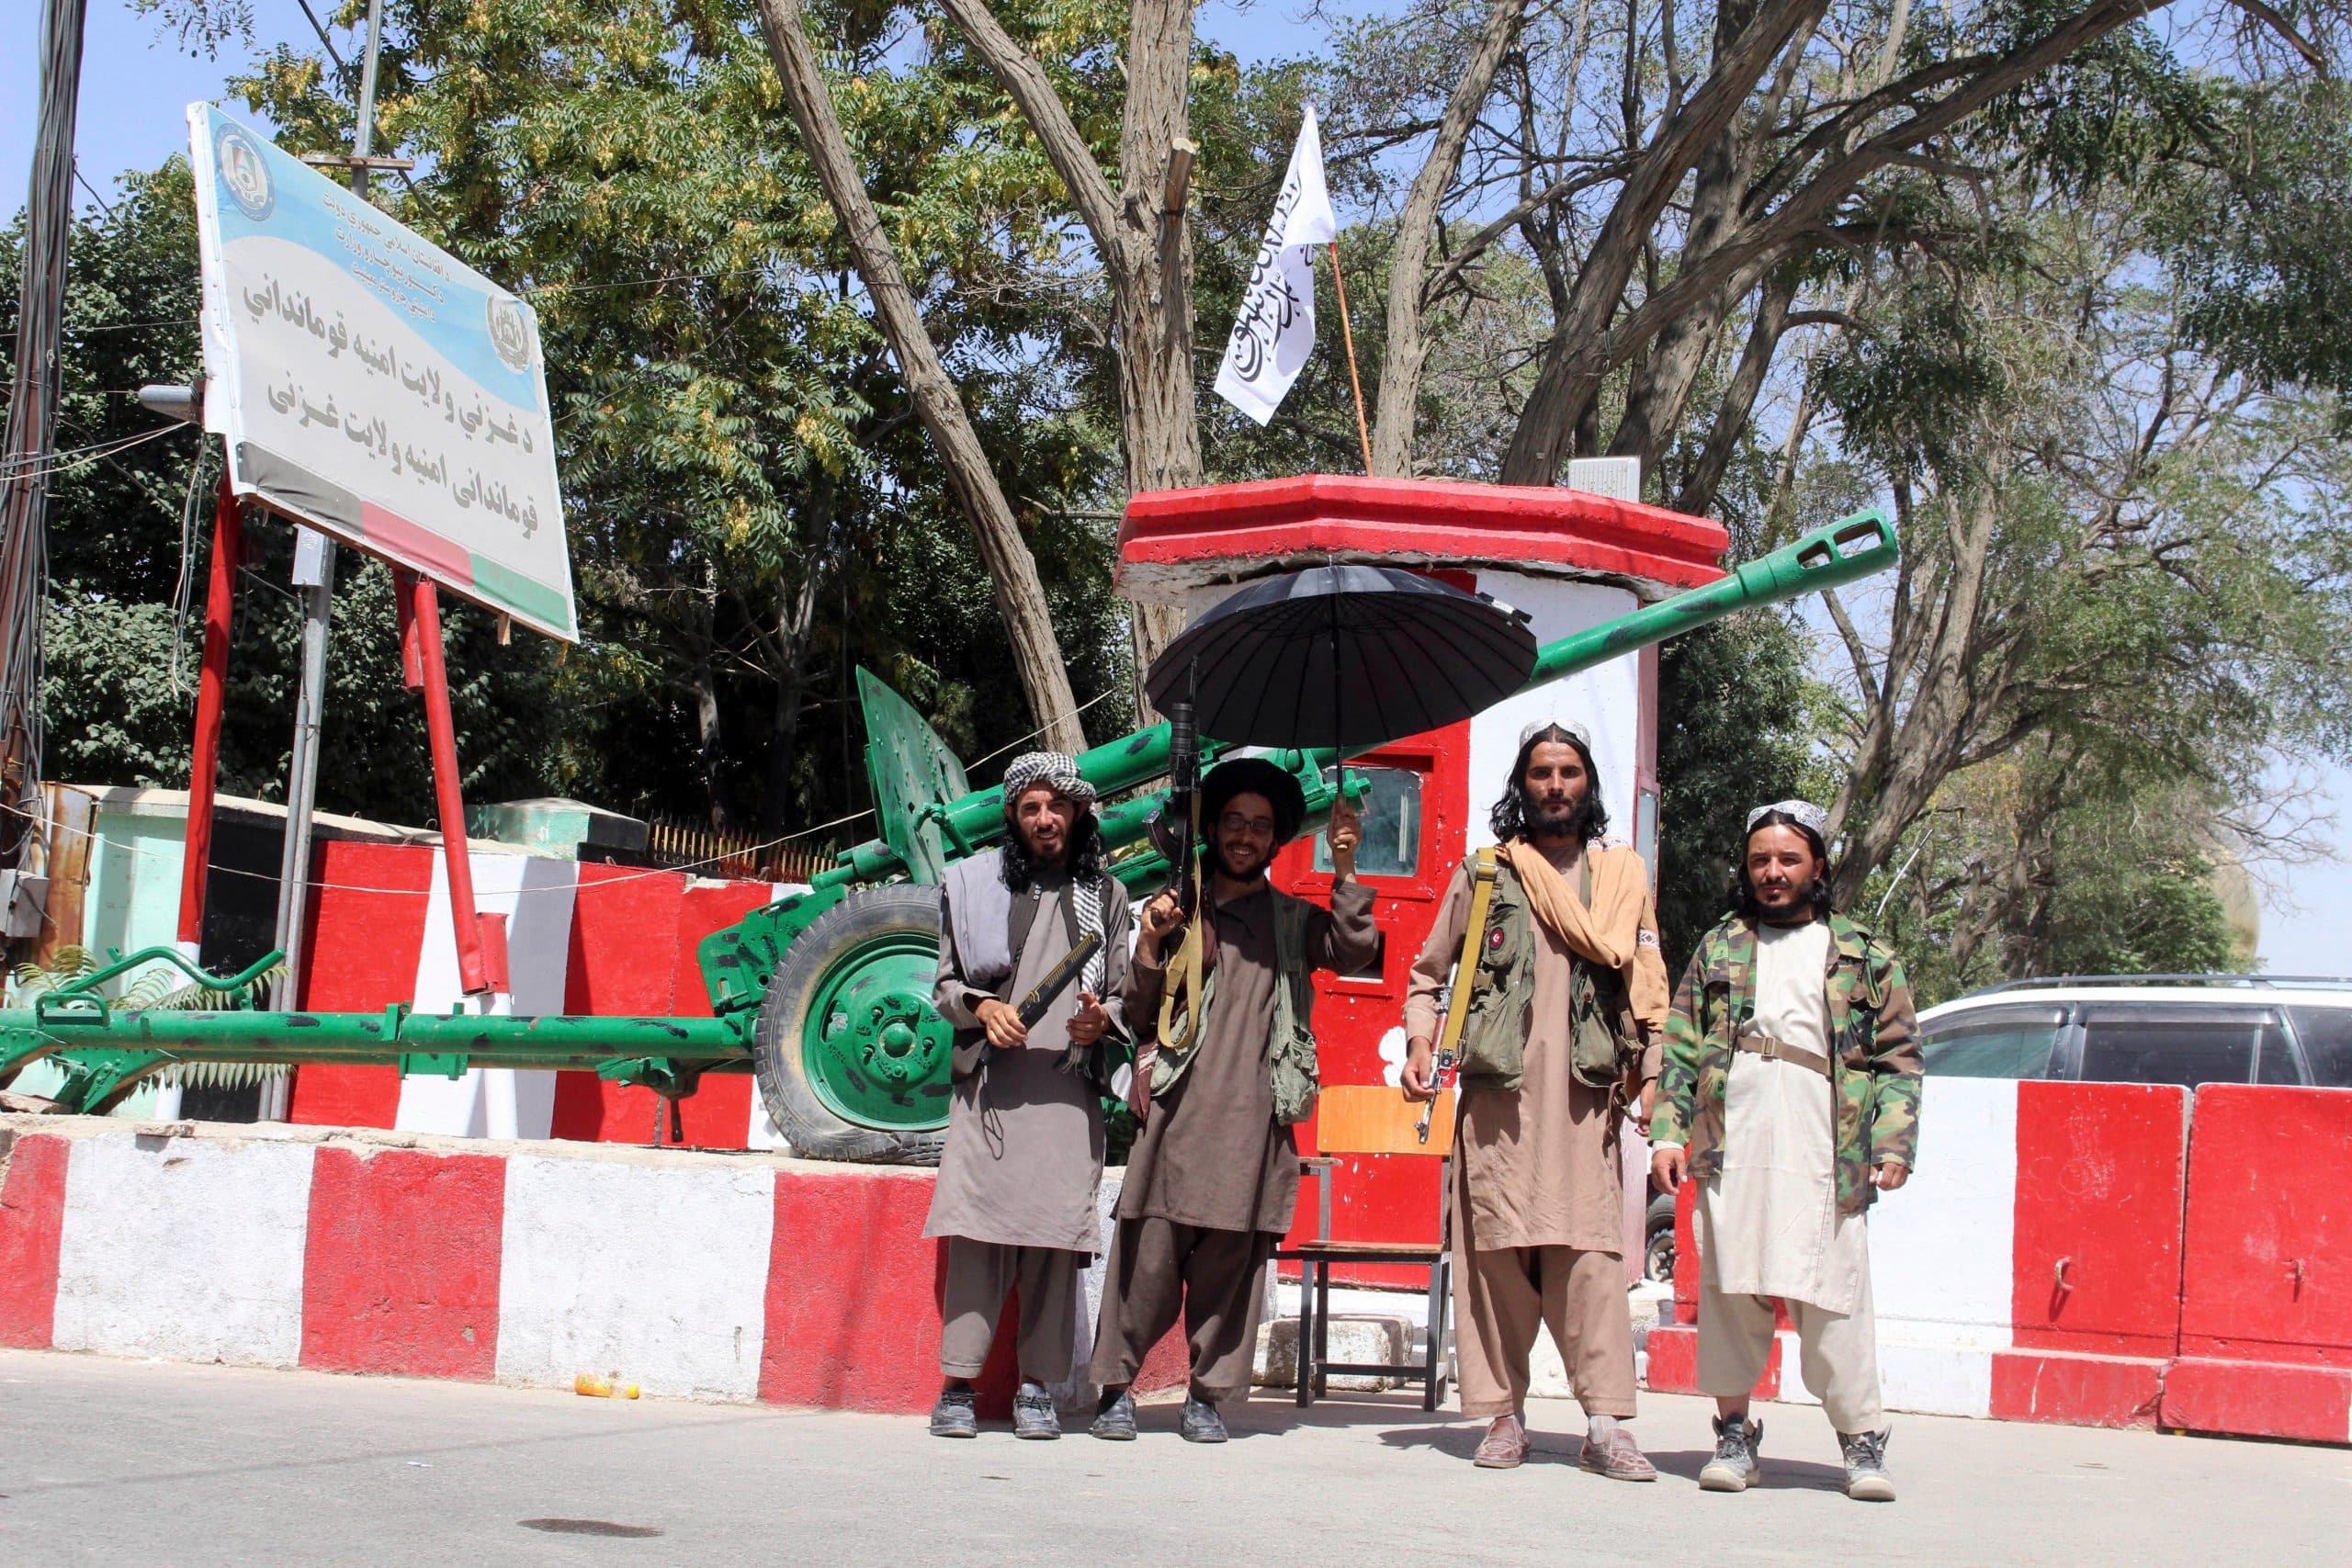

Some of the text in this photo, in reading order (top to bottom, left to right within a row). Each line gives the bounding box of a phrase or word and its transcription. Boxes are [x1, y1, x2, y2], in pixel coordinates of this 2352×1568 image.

[243, 273, 533, 454] د غزني ولایت امنیه قومانداني
[268, 371, 537, 539] قوماندانی امنیه ولایت غزنی
